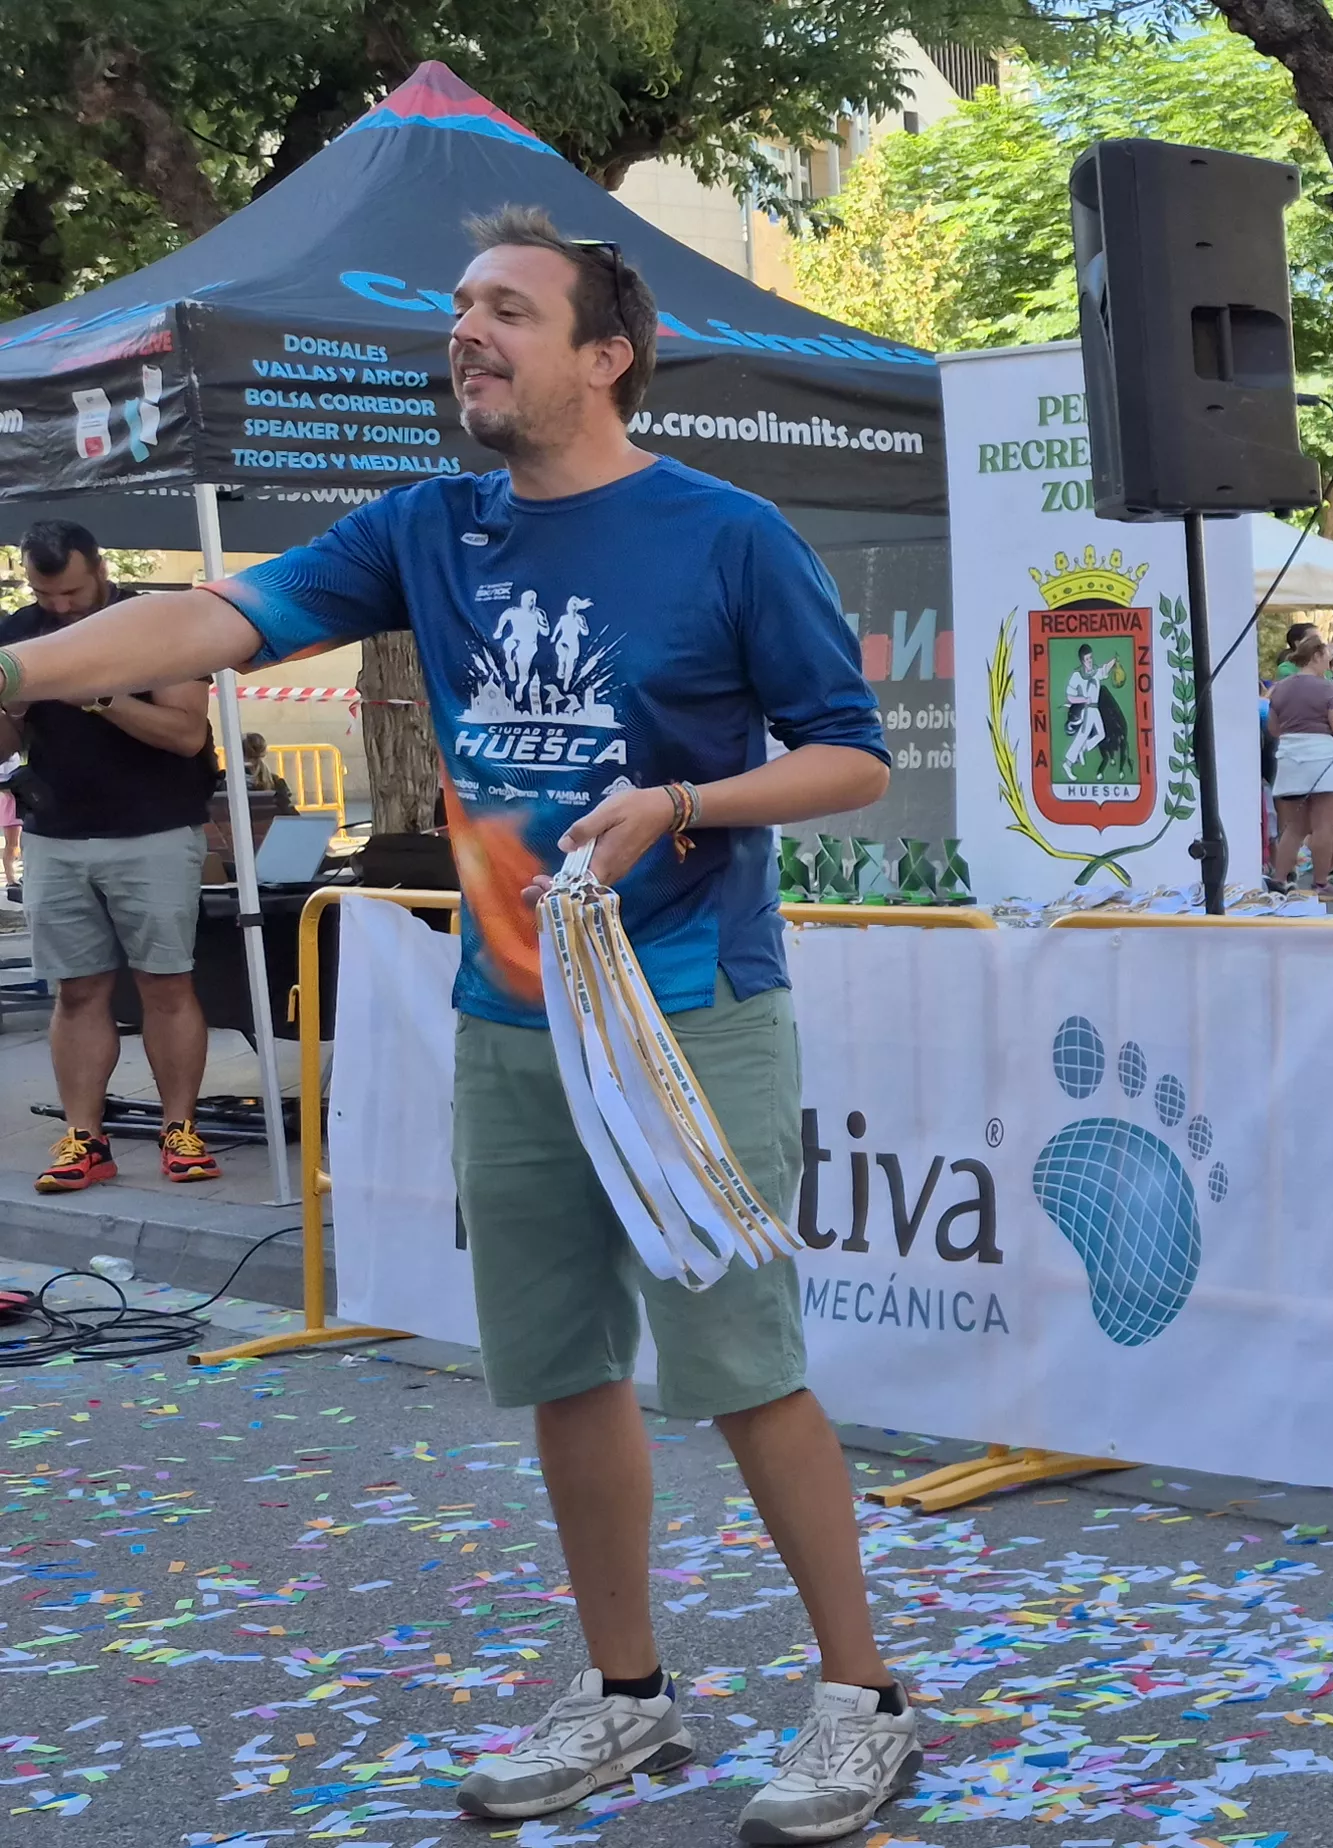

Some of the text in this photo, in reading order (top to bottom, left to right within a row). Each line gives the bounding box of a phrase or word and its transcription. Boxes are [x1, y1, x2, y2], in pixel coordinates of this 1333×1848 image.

[283, 333, 389, 363] DORSALES
[252, 359, 429, 388] VALLAS Y ARCOS
[244, 388, 437, 417] BOLSA CORREDOR
[1037, 393, 1087, 426] PE
[244, 418, 441, 446] SPEAKER Y SONIDO
[628, 410, 923, 454] w.cronolimits.com
[231, 448, 461, 475] TROFEOS Y MEDALLAS
[978, 437, 1090, 474] RECRE
[1041, 612, 1143, 634] RECREATIVA
[488, 725, 565, 737] CIUDAD DE
[455, 730, 627, 765] HUESCA
[554, 789, 590, 801] AMBAR
[1067, 786, 1130, 797] HUESCA
[798, 1108, 1004, 1264] tiva
[803, 1272, 1010, 1334] MECÁNICA
